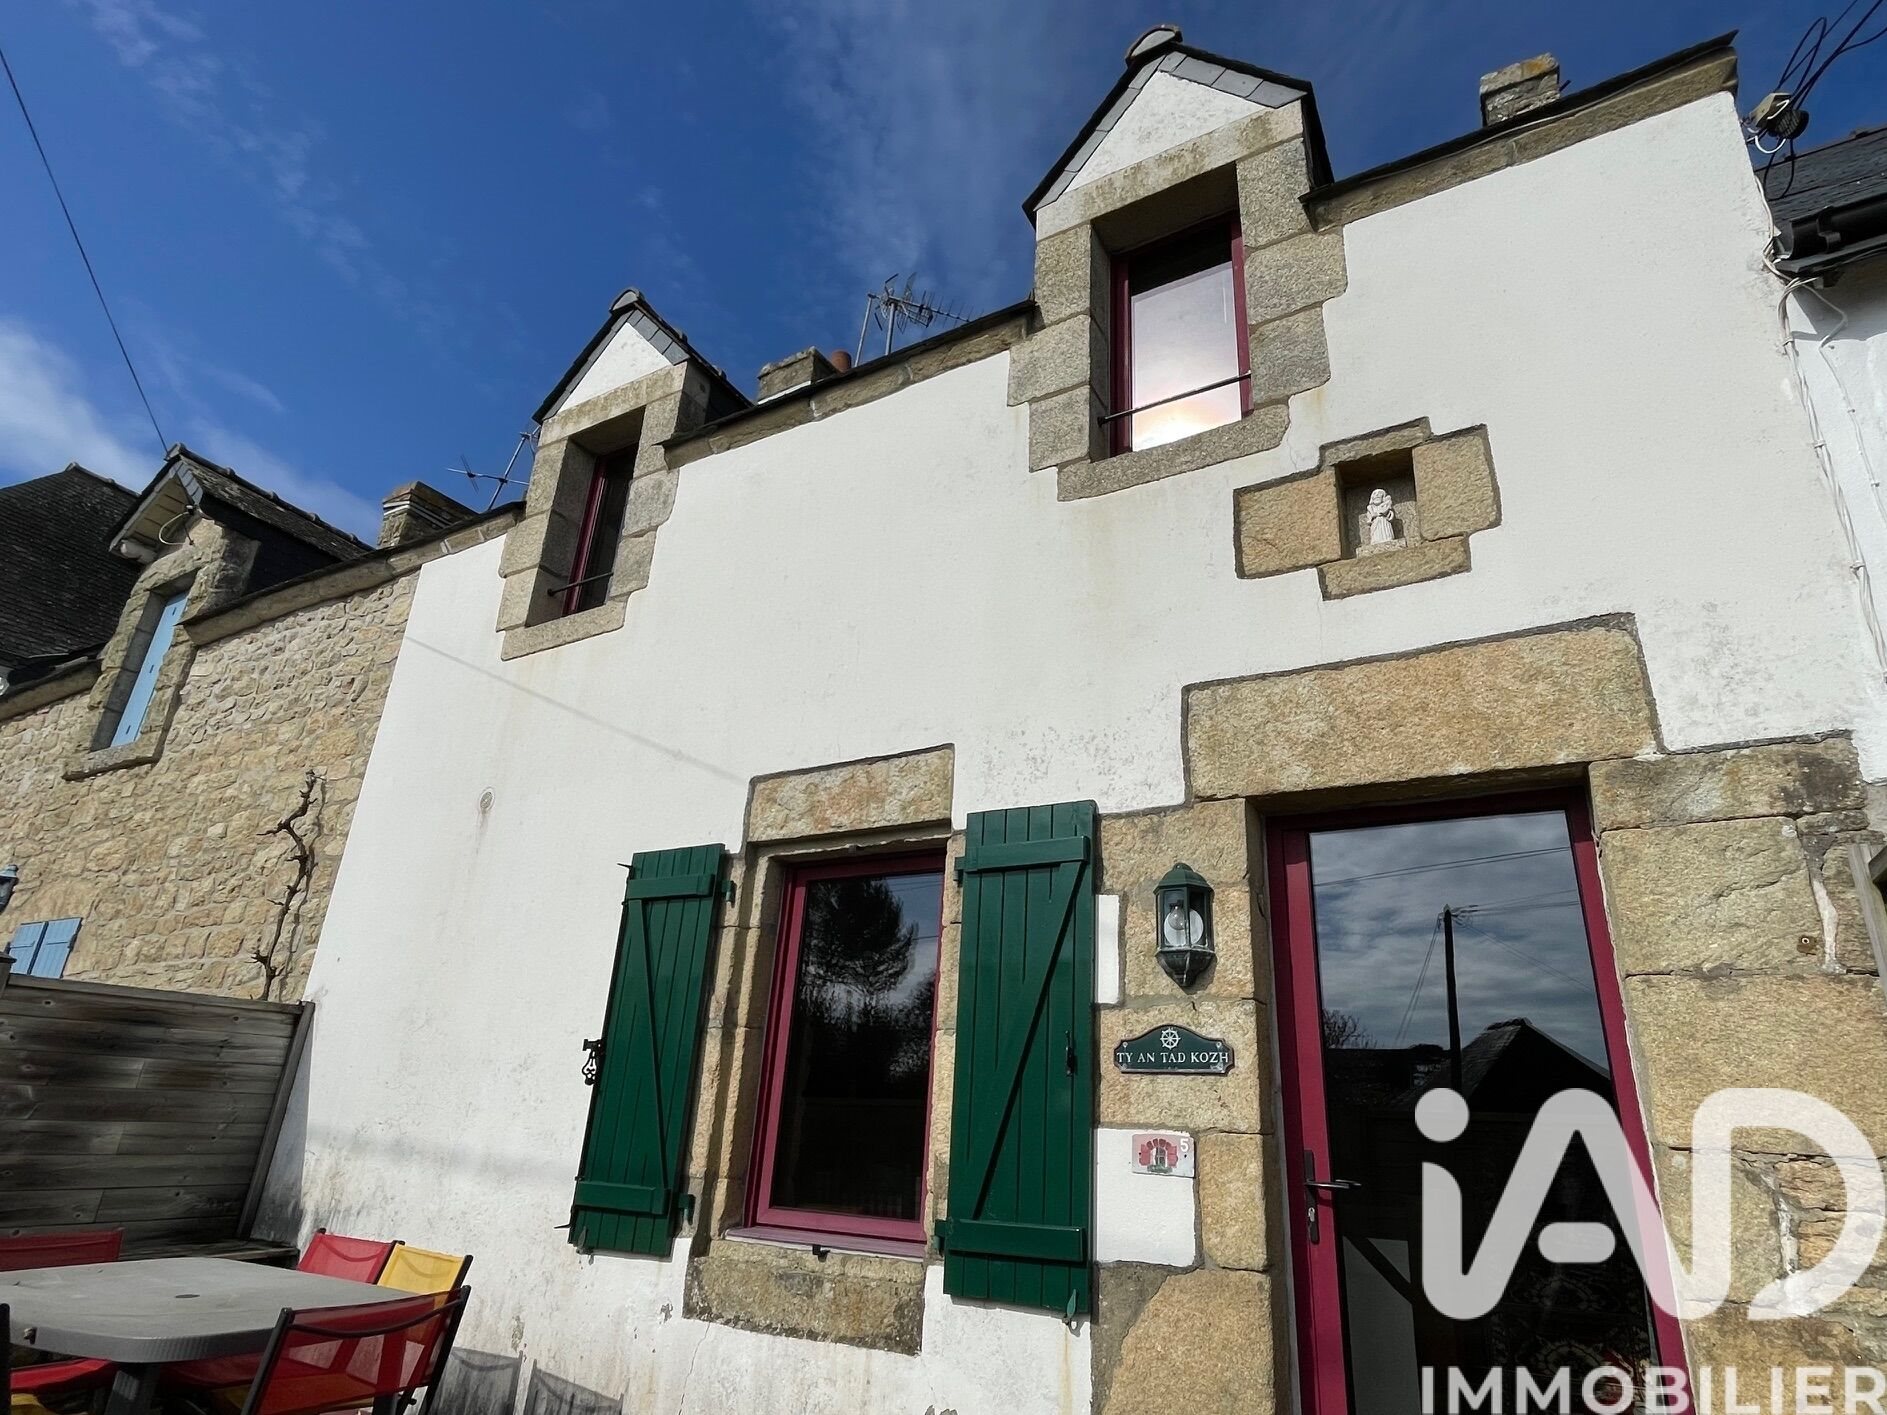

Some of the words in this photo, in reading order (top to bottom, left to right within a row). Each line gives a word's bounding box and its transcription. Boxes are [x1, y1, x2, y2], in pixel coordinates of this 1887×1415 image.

[1117, 1052, 1133, 1063] TY
[1137, 1052, 1155, 1063] AN
[1160, 1052, 1186, 1063] TAD
[1190, 1052, 1229, 1063] KOZH
[1179, 1137, 1189, 1152] 5
